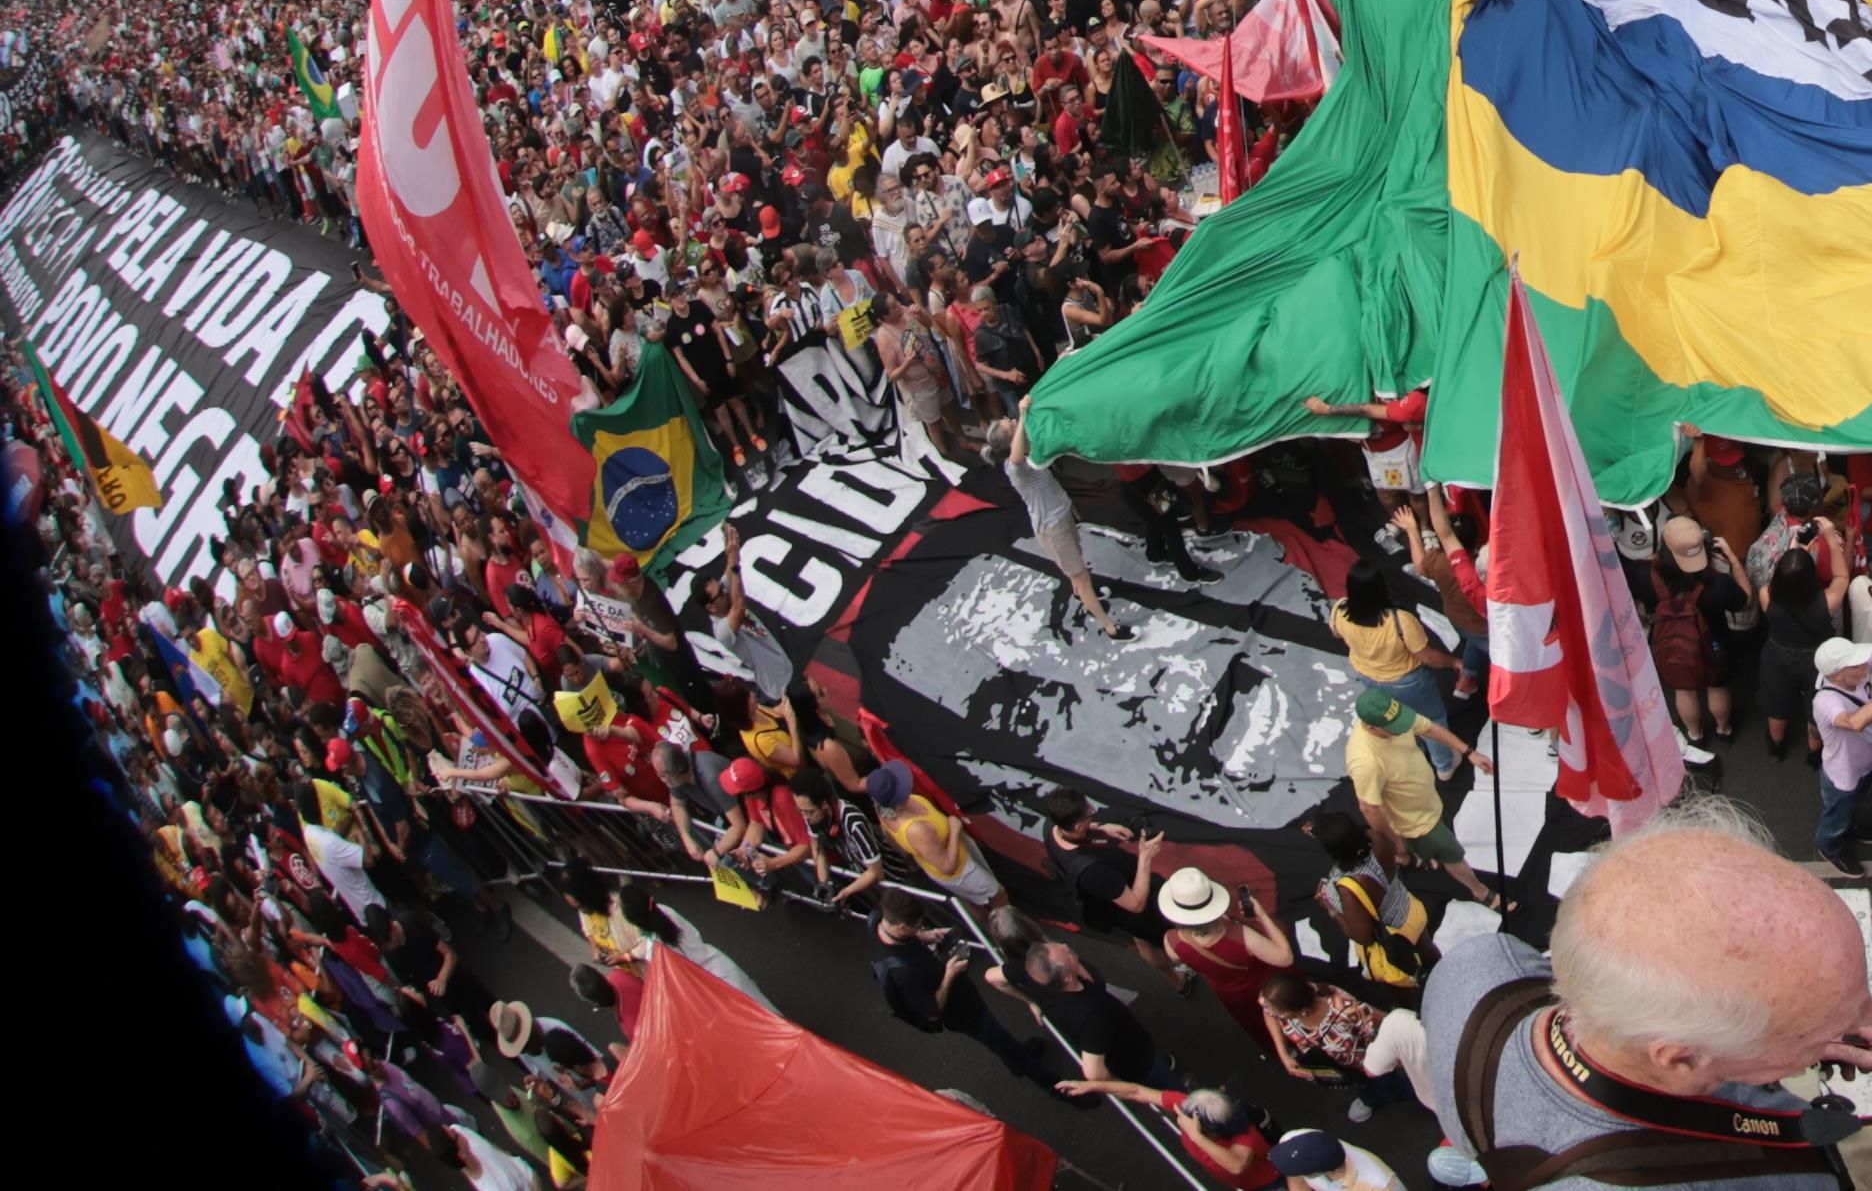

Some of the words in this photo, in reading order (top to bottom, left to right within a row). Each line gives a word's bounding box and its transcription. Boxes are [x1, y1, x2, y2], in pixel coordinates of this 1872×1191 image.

[94, 187, 209, 303] PELA
[162, 227, 318, 387] VIDA
[27, 267, 140, 415] POVO
[98, 344, 272, 611] NEGR
[1732, 1111, 1781, 1137] Canon
